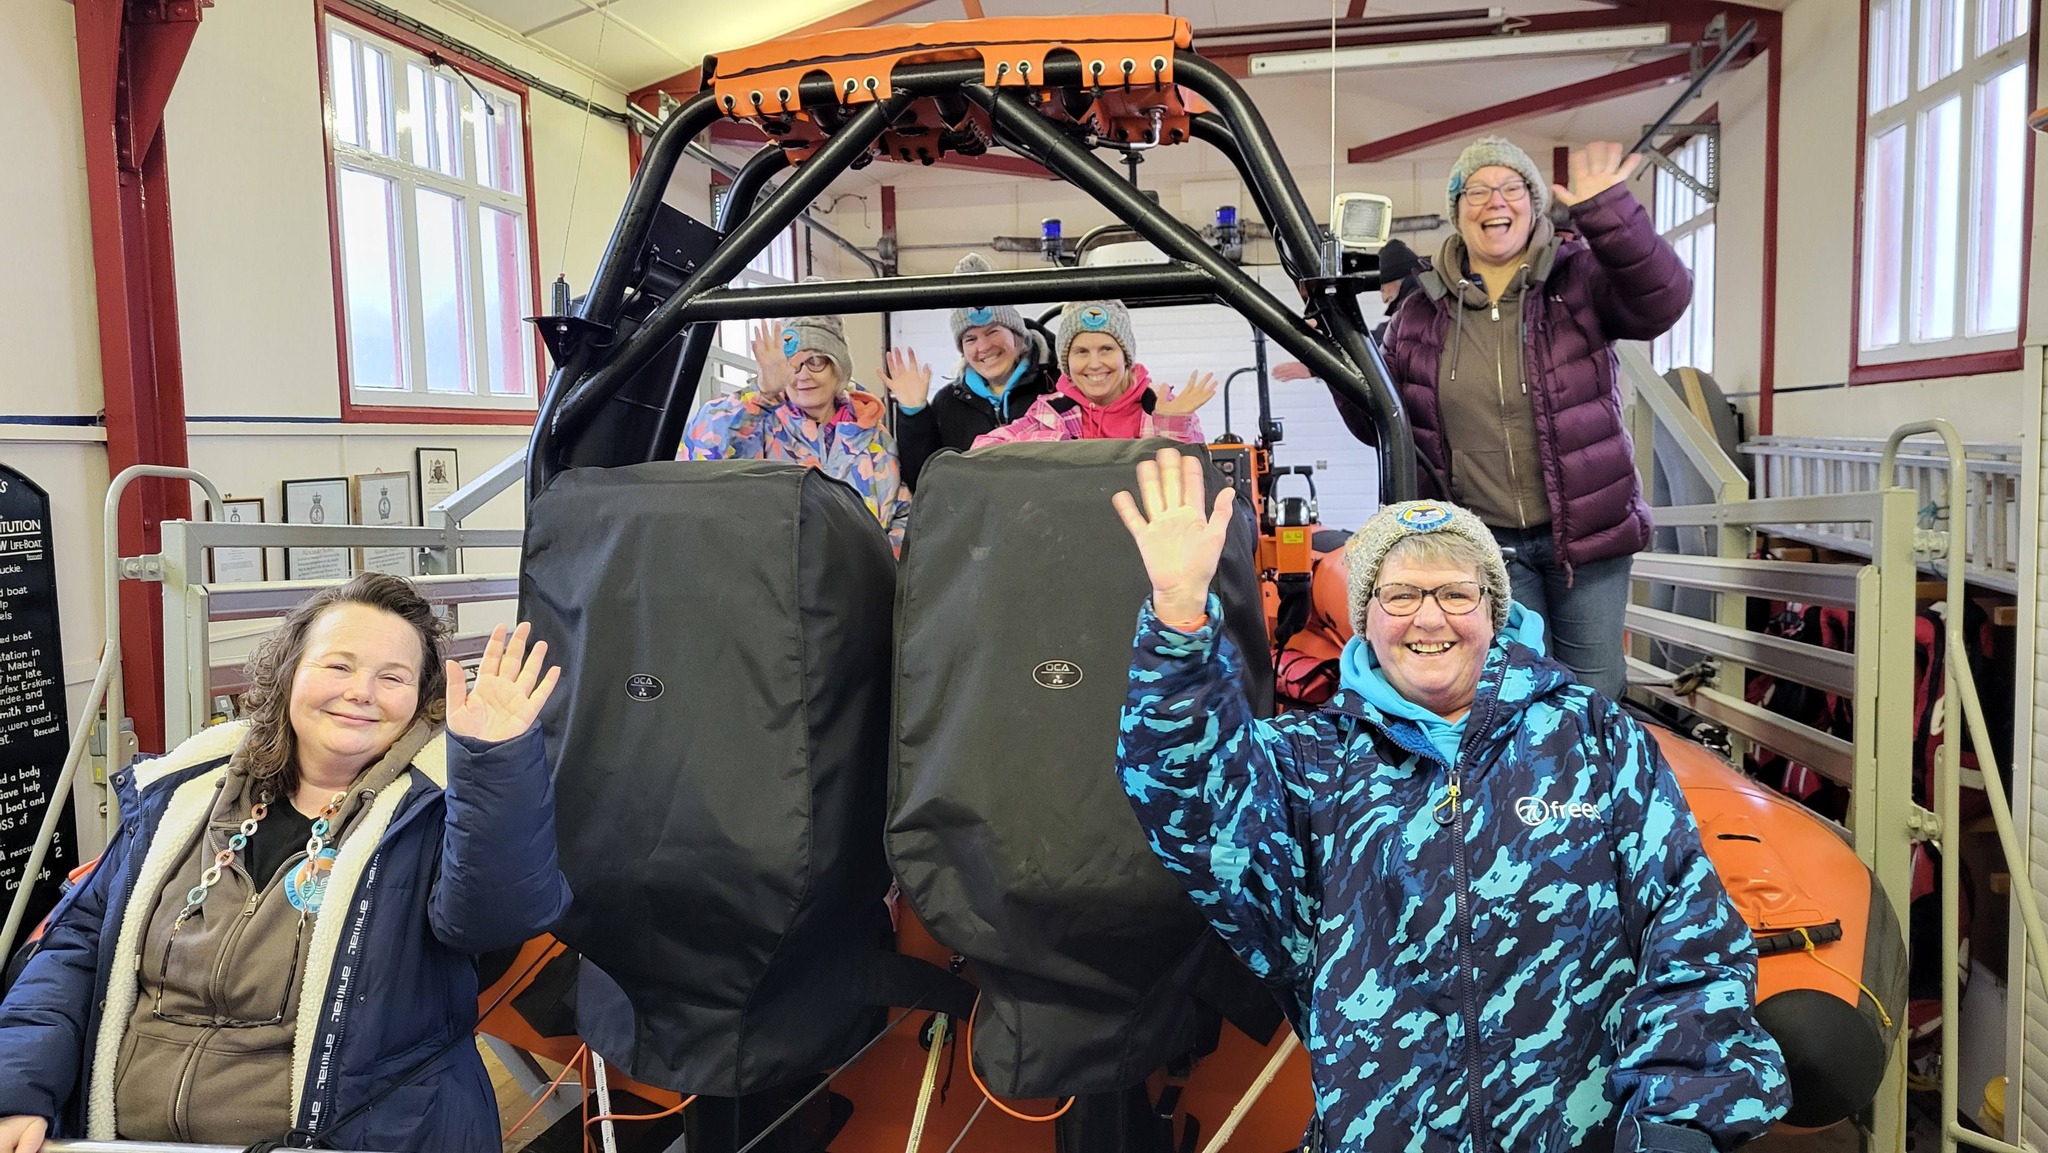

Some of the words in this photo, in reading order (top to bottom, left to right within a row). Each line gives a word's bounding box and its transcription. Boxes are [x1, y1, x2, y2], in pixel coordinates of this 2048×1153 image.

[7, 586, 28, 596] boat
[13, 631, 33, 641] boat
[31, 647, 41, 657] in
[8, 658, 36, 671] Mabel
[1046, 663, 1070, 671] OCA
[6, 674, 21, 683] her
[25, 669, 42, 679] late
[633, 677, 653, 685] OCA
[0, 685, 19, 696] rfax
[25, 688, 43, 700] and
[26, 700, 45, 713] and
[8, 721, 29, 731] were
[31, 711, 52, 725] used
[34, 722, 60, 737] Rescued
[19, 765, 40, 779] body
[23, 780, 40, 793] help
[6, 799, 27, 814] boat
[30, 792, 46, 806] and
[19, 812, 28, 825] of
[53, 832, 61, 844] 2
[10, 845, 35, 858] rescu
[55, 846, 63, 858] 2
[36, 866, 51, 880] elp
[331, 965, 352, 1022] animal
[316, 1033, 336, 1089] animal
